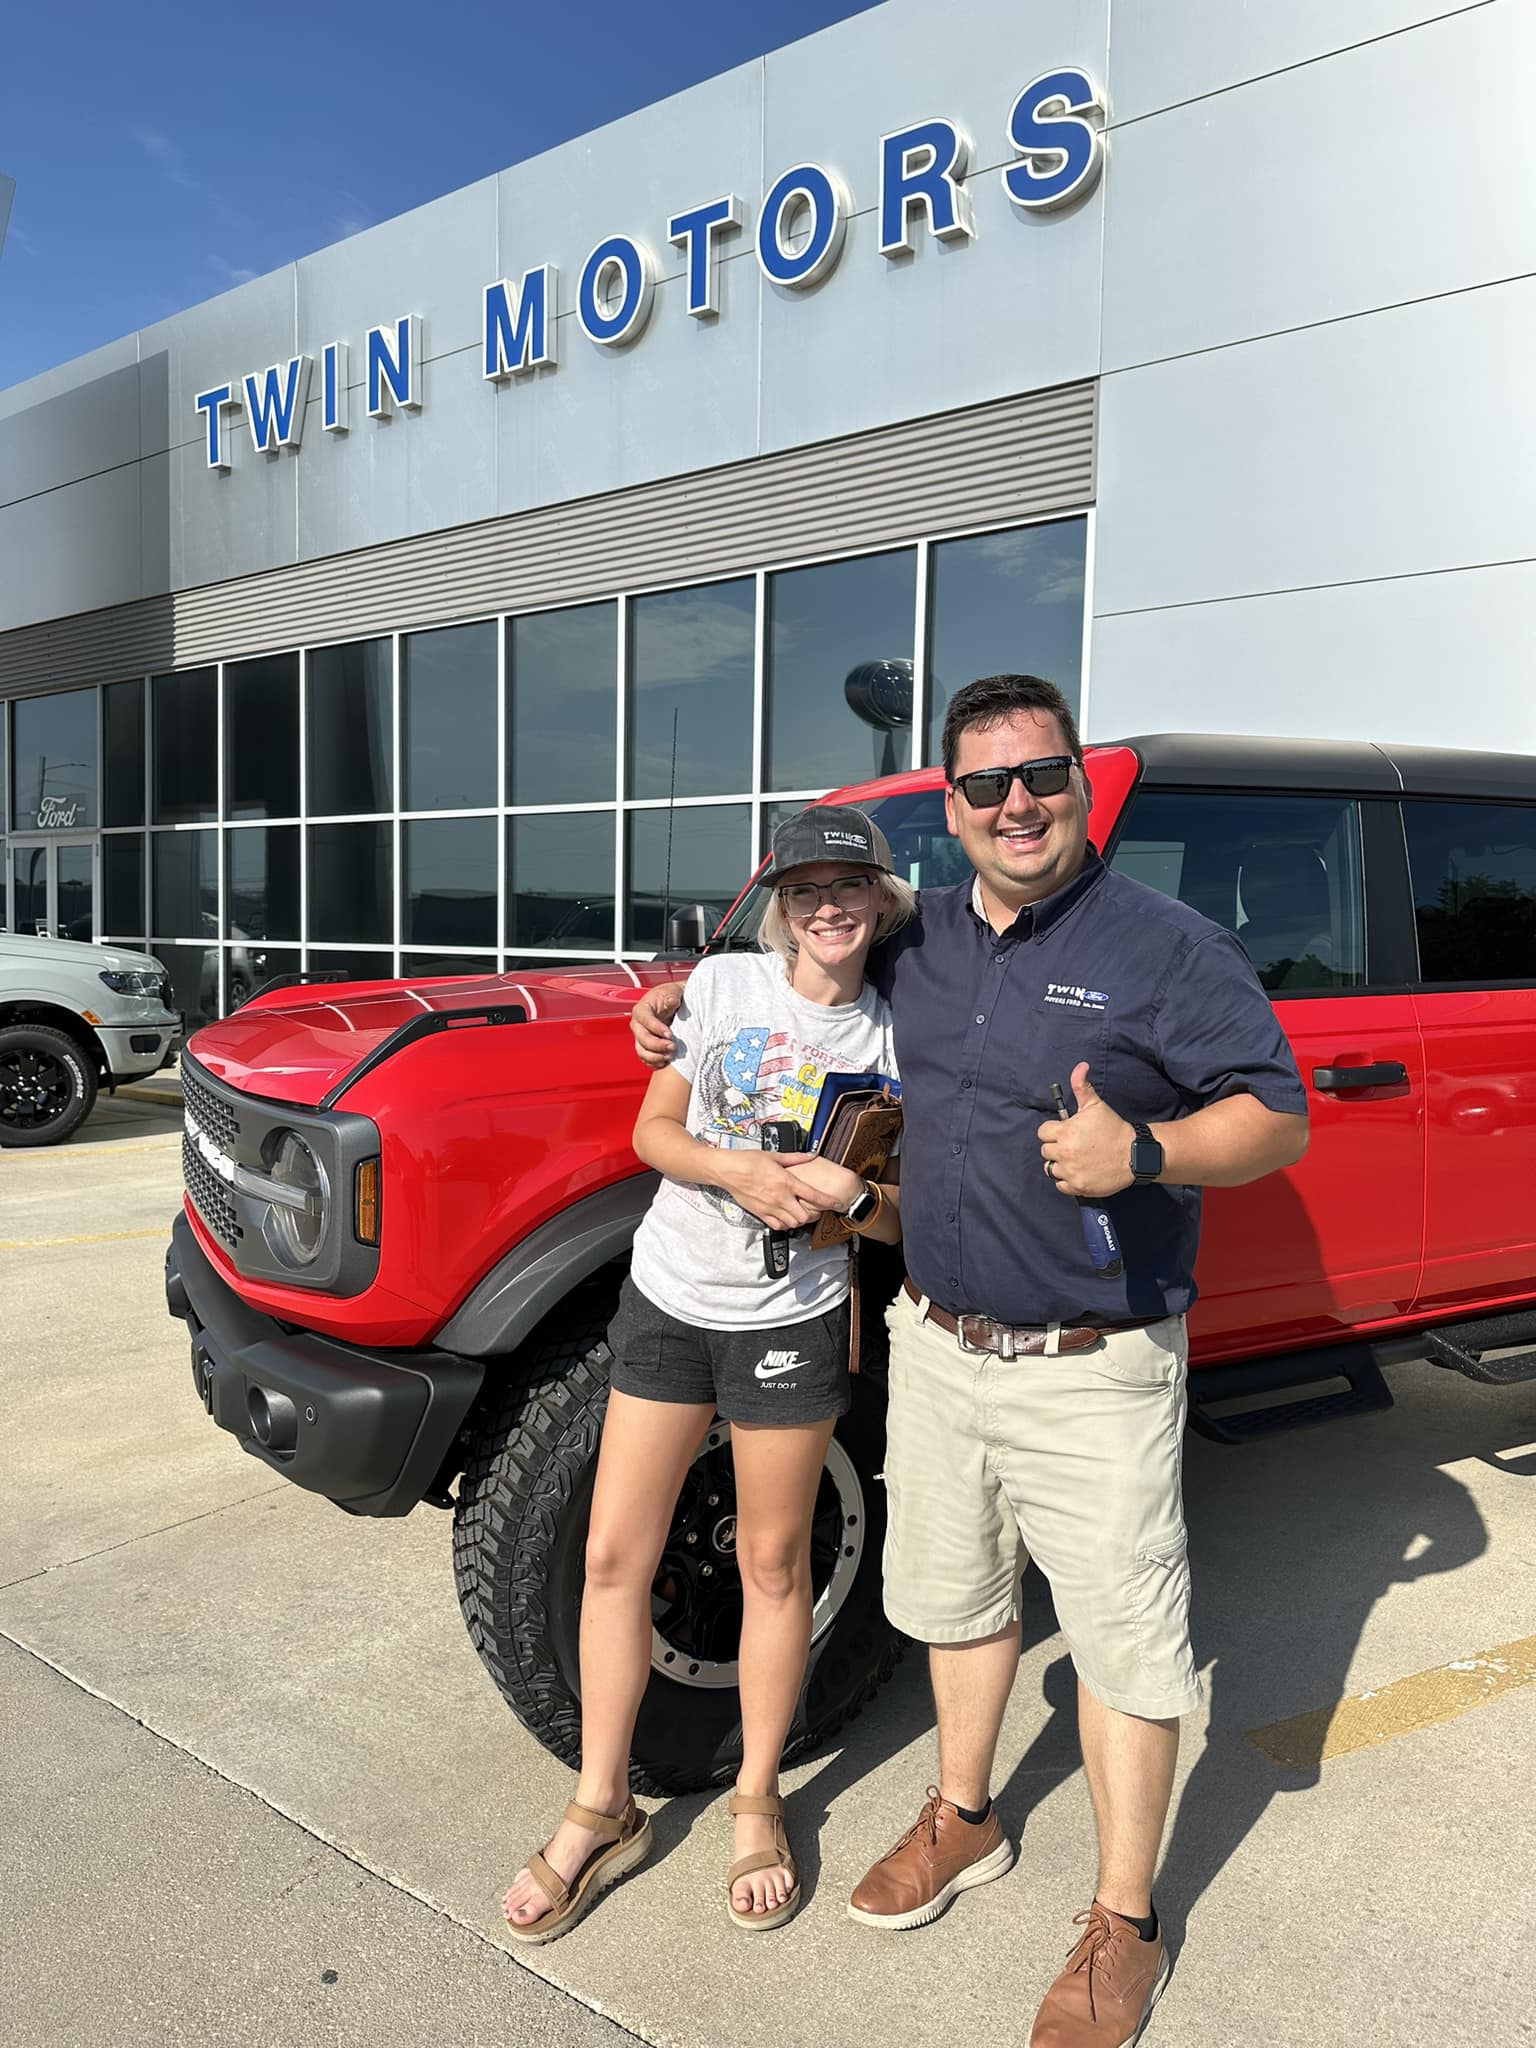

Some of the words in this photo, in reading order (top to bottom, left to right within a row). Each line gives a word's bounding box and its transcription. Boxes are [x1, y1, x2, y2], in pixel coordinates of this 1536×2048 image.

[195, 311, 424, 469] TWIN
[483, 67, 1109, 382] MOTORS
[37, 796, 76, 828] Ford
[1047, 983, 1086, 1000] TWIN
[763, 1350, 799, 1367] NIKE
